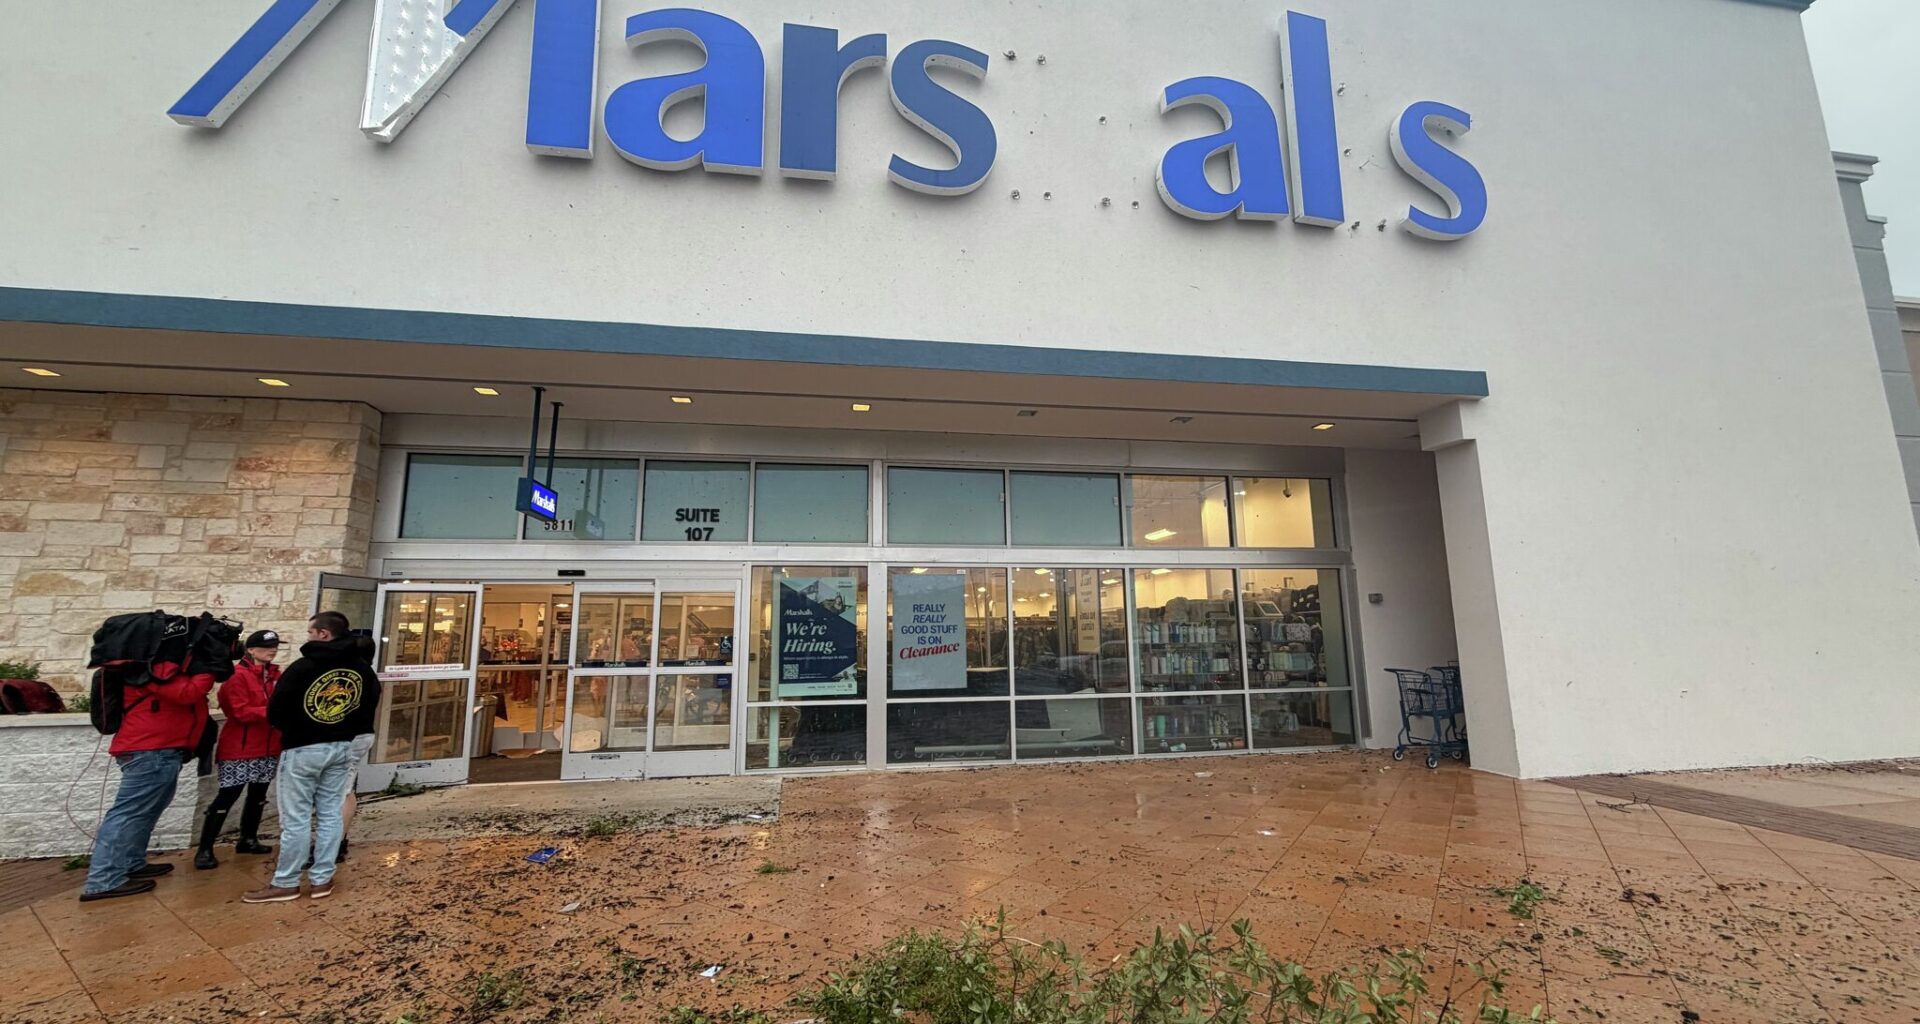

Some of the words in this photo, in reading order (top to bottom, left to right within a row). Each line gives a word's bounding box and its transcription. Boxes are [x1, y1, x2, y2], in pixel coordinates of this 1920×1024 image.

[531, 489, 556, 513] Marshalls
[675, 507, 720, 523] SUITE
[544, 519, 573, 531] 5811
[684, 526, 715, 541] 107
[912, 603, 946, 613] REALLY
[912, 614, 947, 624] REALLY
[786, 622, 827, 636] We're
[901, 625, 928, 635] GOOD
[930, 624, 958, 634] STUFF
[783, 639, 837, 655] Hiring.
[917, 636, 927, 645] IS
[928, 636, 942, 645] ON
[899, 642, 960, 660] Clearance
